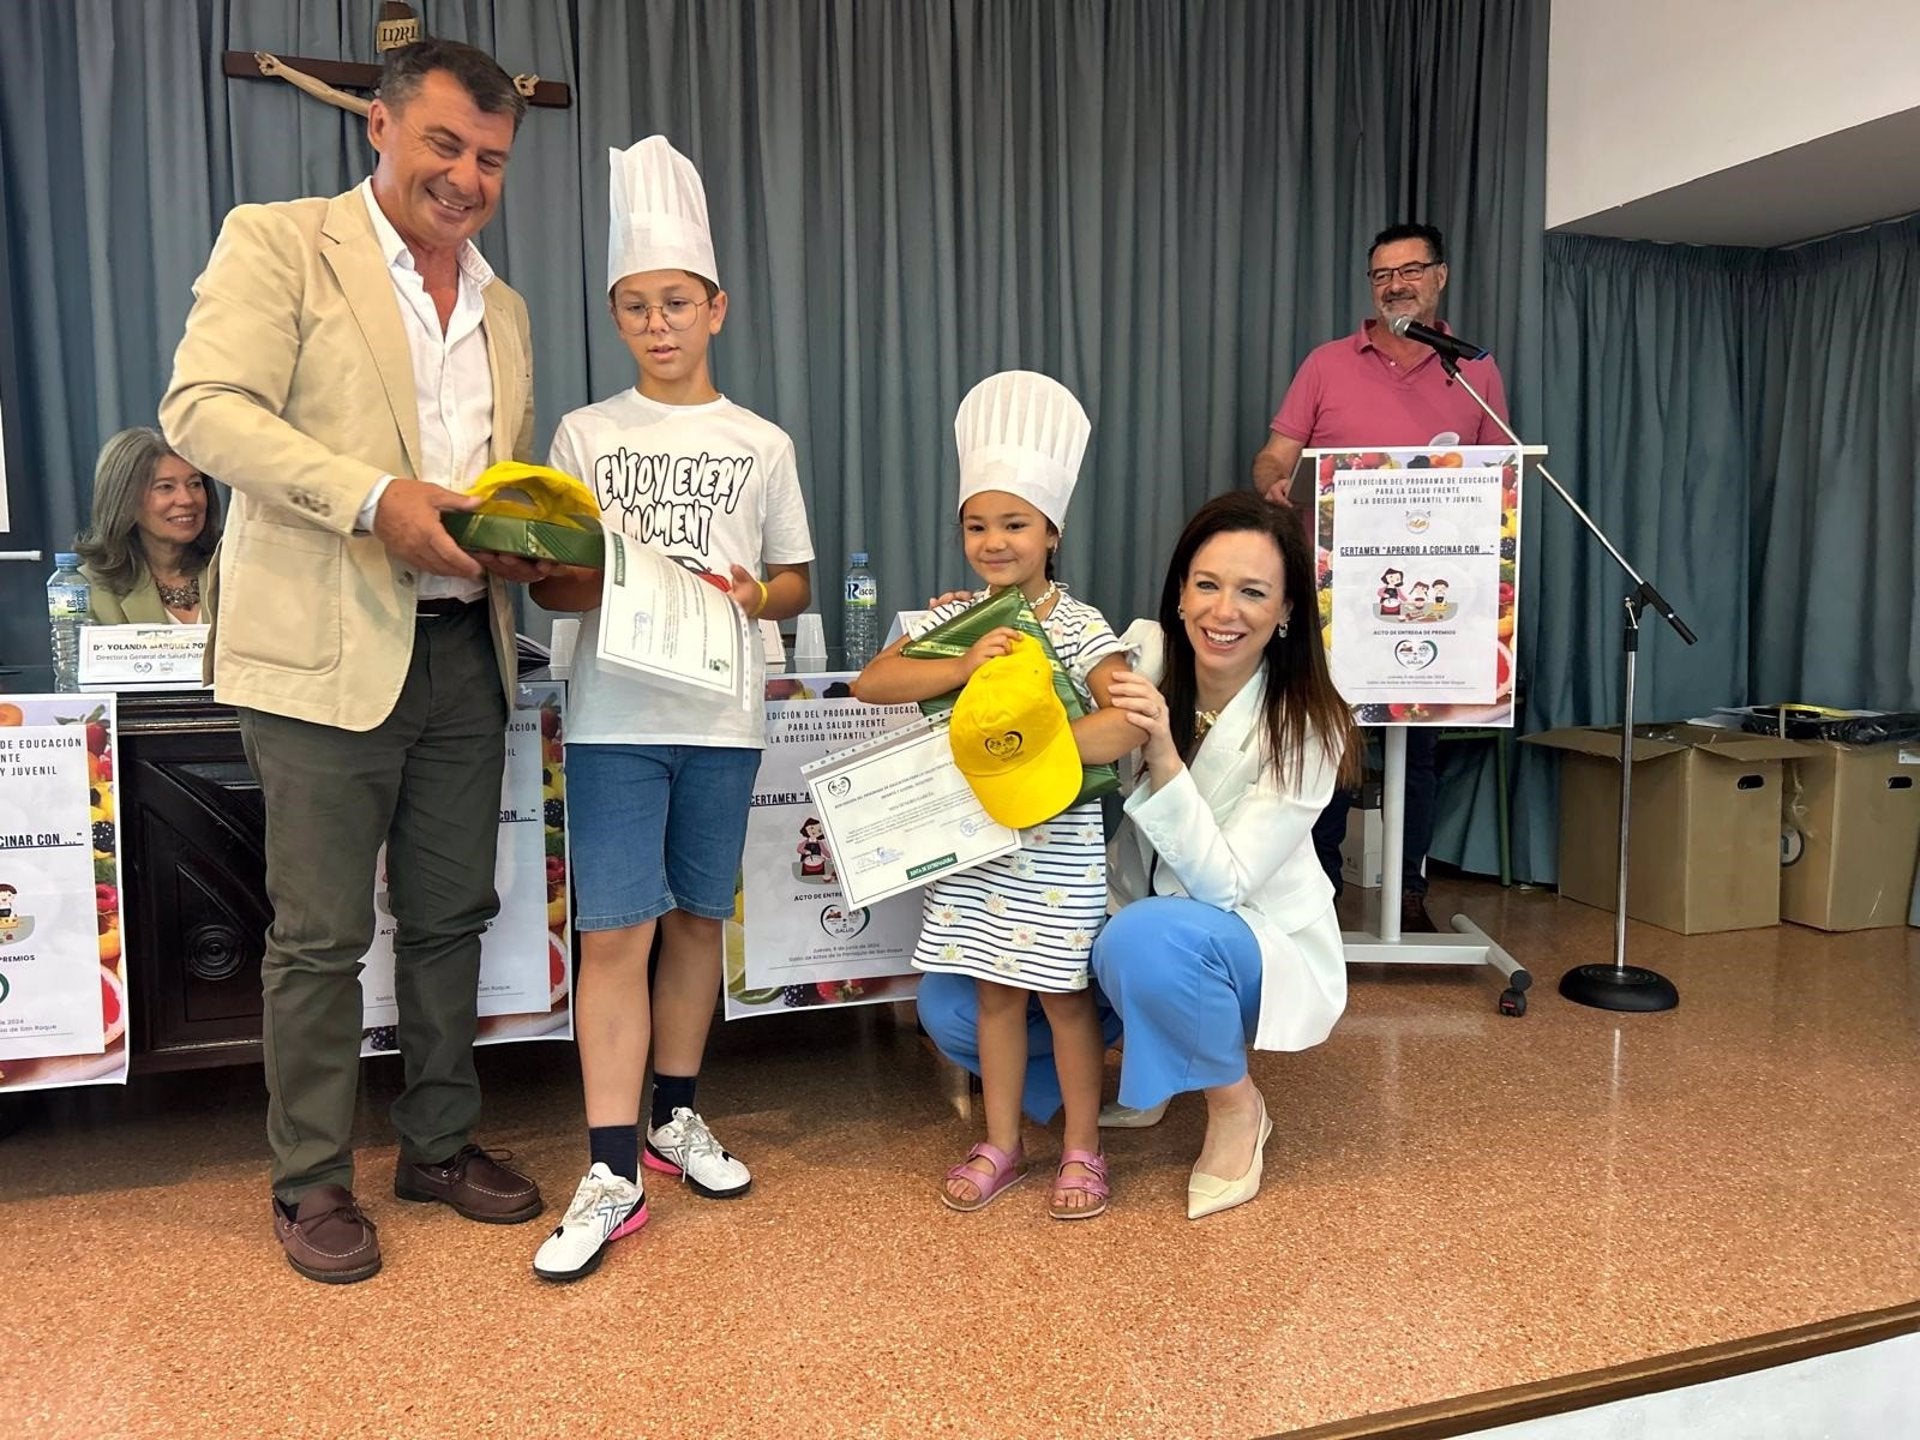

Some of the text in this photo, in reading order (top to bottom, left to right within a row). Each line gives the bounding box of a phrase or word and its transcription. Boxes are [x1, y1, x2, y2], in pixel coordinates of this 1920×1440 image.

[383, 26, 415, 46] INRI
[595, 446, 754, 514] ENJOY EVERY
[1358, 477, 1388, 486] EDICIÓN
[1406, 477, 1444, 485] PROGRAMA
[1447, 477, 1456, 485] DE
[1459, 476, 1500, 484] EDUCACIÓN
[623, 499, 713, 556] MOMENT
[1340, 547, 1380, 556] CERTAMEN
[1423, 546, 1428, 554] A
[1430, 545, 1463, 554] COCINAR
[1465, 545, 1479, 553] CON
[107, 643, 148, 651] YOLANDA
[96, 653, 128, 661] Directora
[767, 705, 920, 721] EDICIÓN DEL PROGRAMA DE EDUCACI
[787, 718, 886, 732] PARA LA SALUD FRENTE
[0, 737, 82, 750] DE EDUCACIÓN
[769, 735, 781, 744] LA
[784, 733, 826, 743] OBESIDAD
[828, 732, 867, 741] INFANTIL
[11, 766, 57, 776] JUVENIL
[751, 792, 797, 805] CERTAMEN
[37, 833, 60, 845] CON
[793, 893, 813, 902] ACTO
[822, 891, 843, 899] ENTRE
